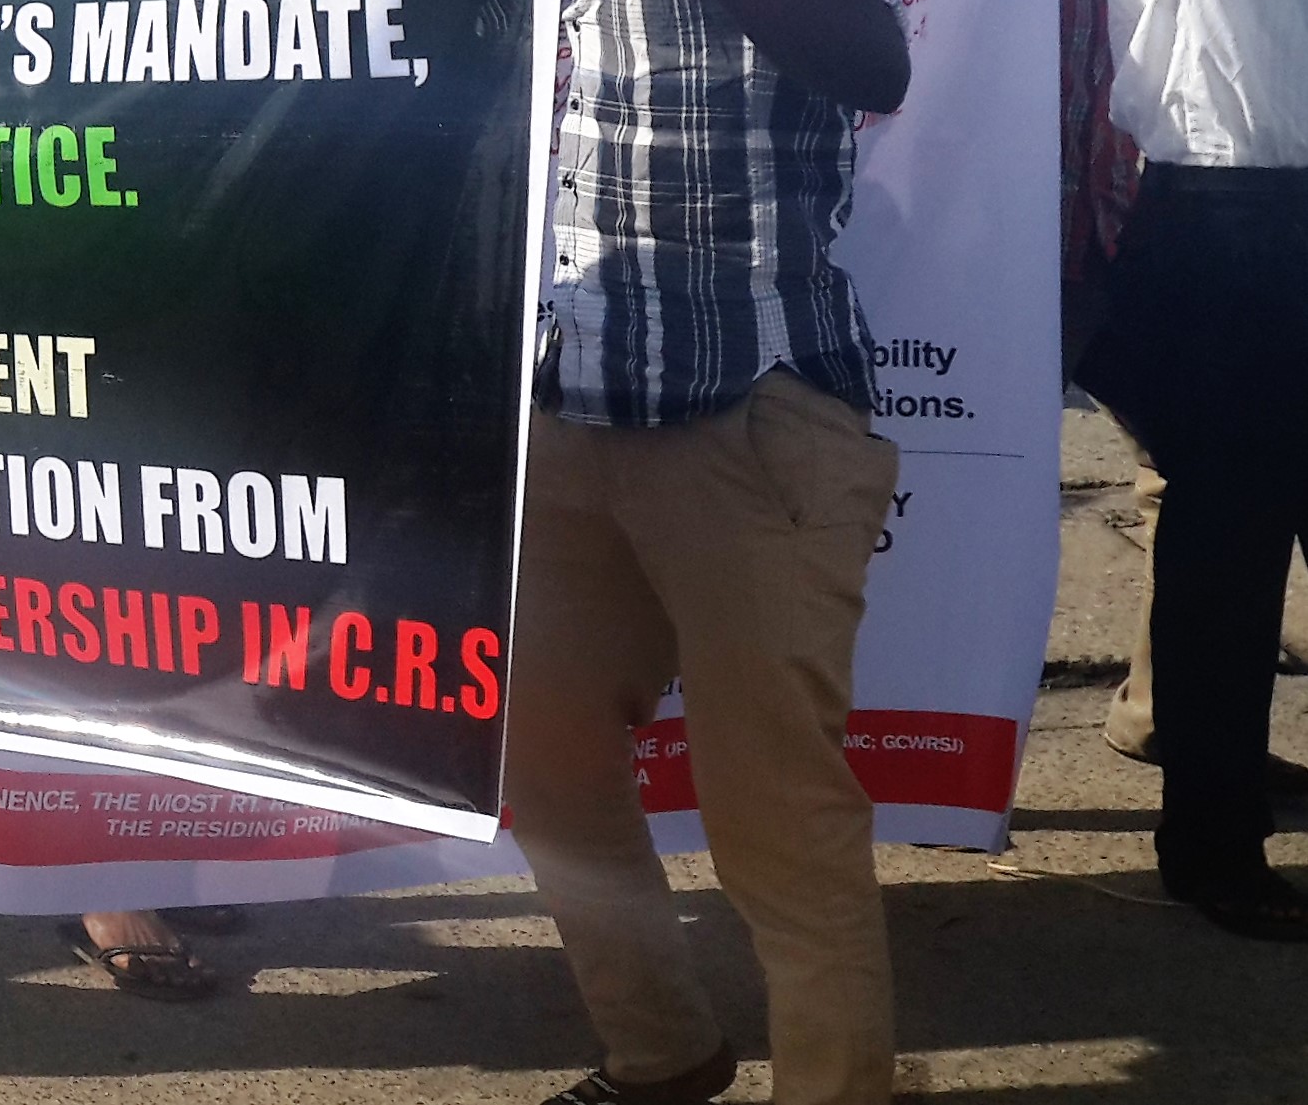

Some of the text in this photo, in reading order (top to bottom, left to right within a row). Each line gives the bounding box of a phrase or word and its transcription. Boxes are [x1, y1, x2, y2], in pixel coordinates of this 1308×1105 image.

[139, 464, 350, 567] FROM
[239, 601, 311, 693] IN
[327, 610, 505, 723] C.R.S
[91, 791, 142, 813] THE
[146, 791, 224, 815] MOST
[229, 794, 263, 815] RT.
[106, 817, 287, 838] THE PRESIDING
